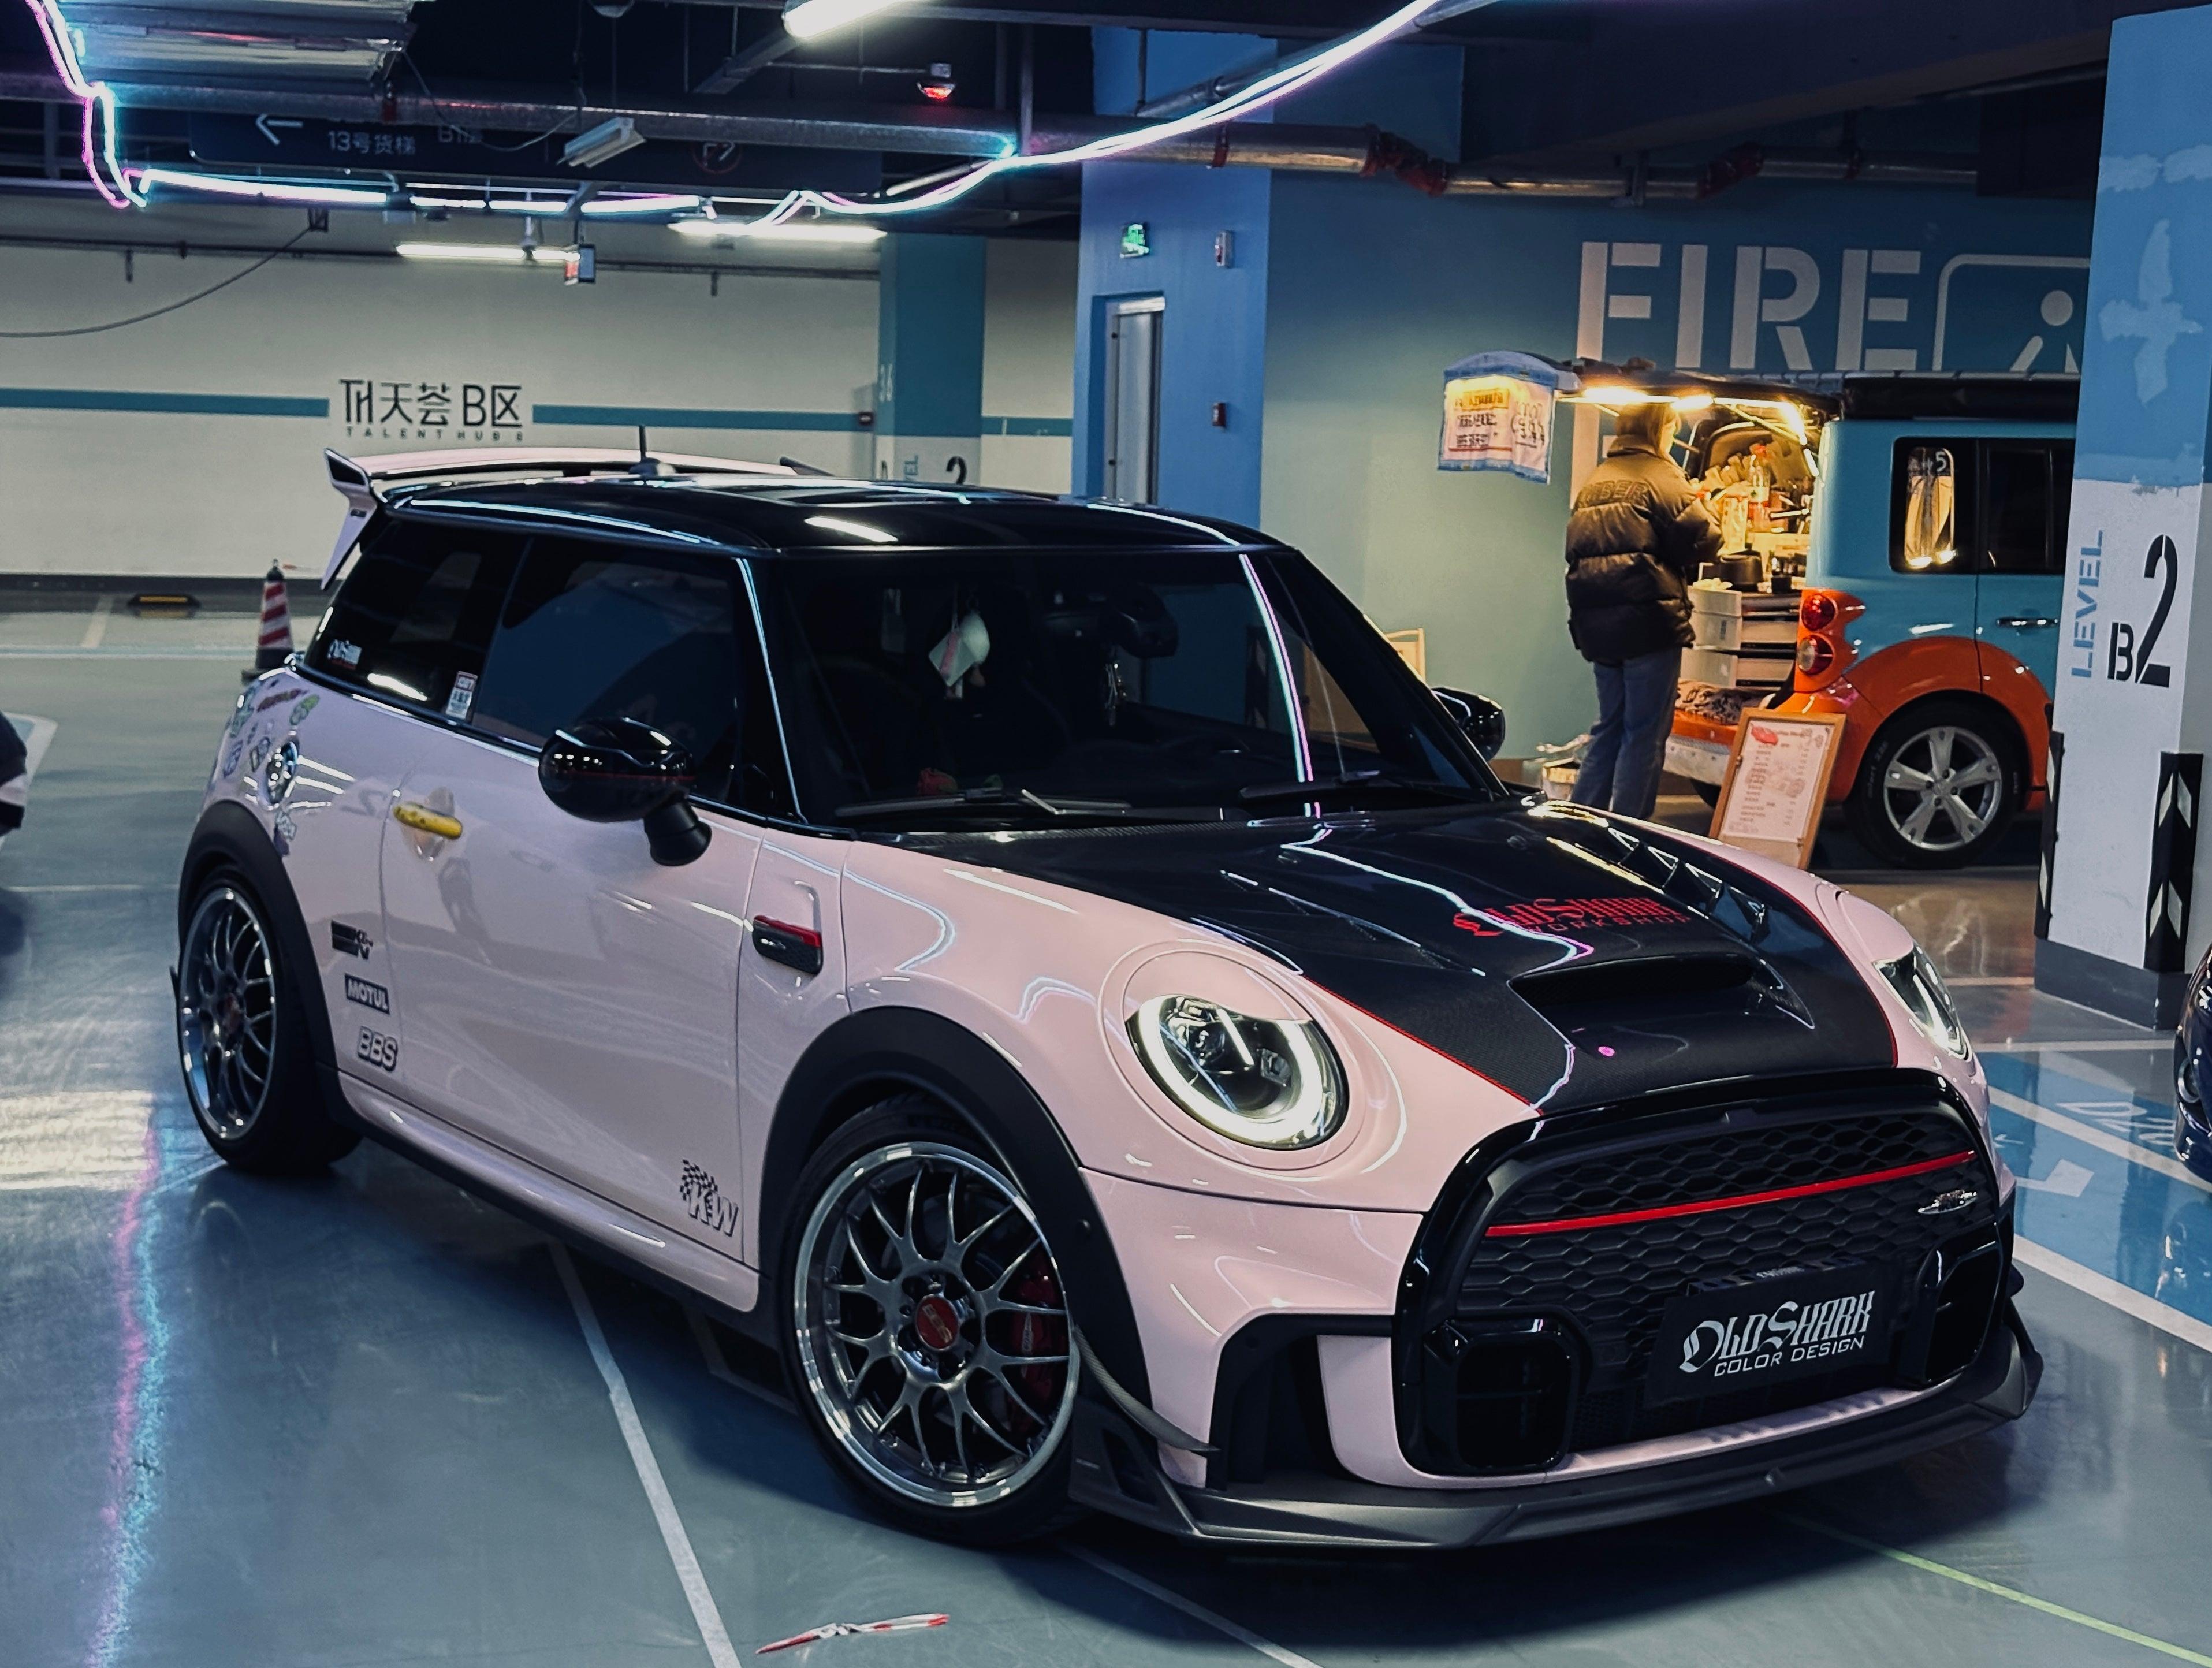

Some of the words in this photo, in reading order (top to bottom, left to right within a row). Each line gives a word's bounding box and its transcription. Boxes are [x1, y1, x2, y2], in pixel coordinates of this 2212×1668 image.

[1577, 241, 1921, 370] FIRE
[347, 426, 444, 440] TALENT
[457, 429, 501, 441] HUB
[2071, 529, 2104, 679] LEVEL
[347, 976, 389, 1011] MOTUL
[357, 1025, 399, 1072] BBS
[1714, 1351, 1783, 1377] COLOR
[1790, 1335, 1865, 1362] DESIGN
